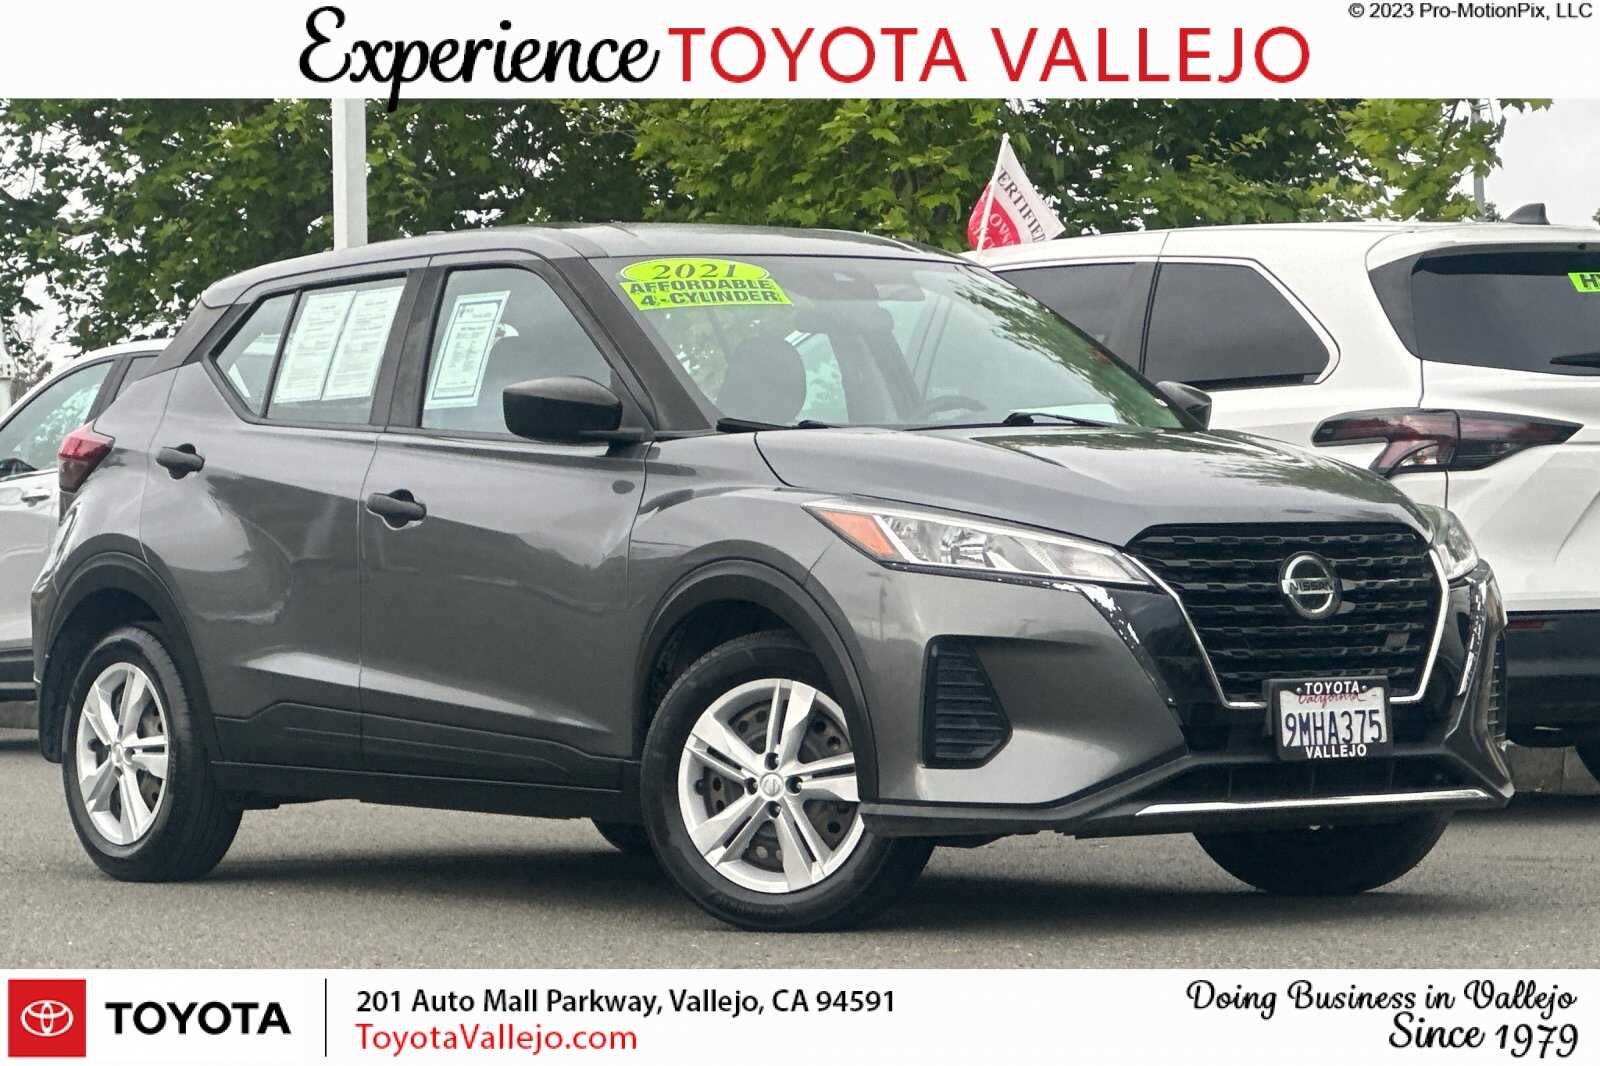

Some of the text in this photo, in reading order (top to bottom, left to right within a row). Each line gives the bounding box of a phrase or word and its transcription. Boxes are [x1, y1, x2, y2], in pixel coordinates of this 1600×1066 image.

[996, 170, 1046, 242] ERTIFIED
[652, 263, 737, 280] 2021
[629, 278, 774, 294] AFFORDABLE
[640, 290, 778, 307] 4-CYLINDER
[1288, 580, 1334, 592] NISSAN
[1304, 681, 1360, 695] TOYOTA
[1285, 710, 1383, 746] 9MHA375
[1305, 744, 1368, 759] VALLEJO
